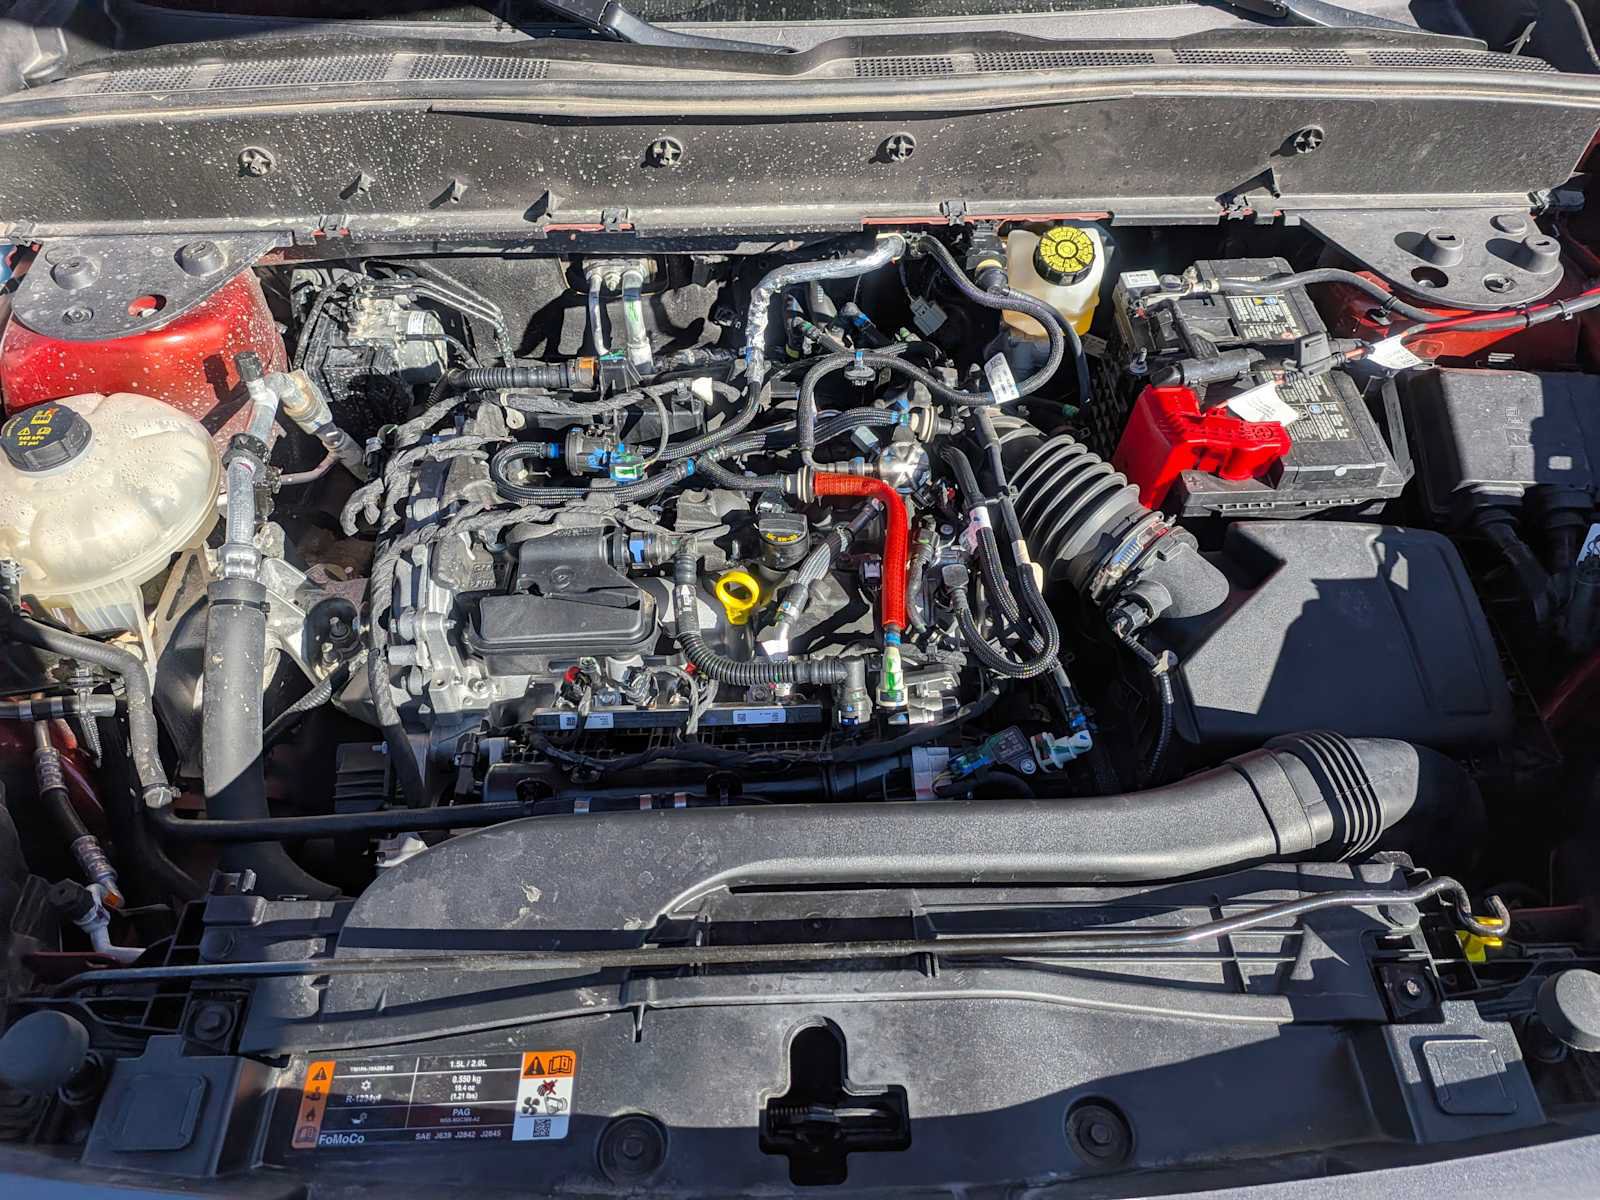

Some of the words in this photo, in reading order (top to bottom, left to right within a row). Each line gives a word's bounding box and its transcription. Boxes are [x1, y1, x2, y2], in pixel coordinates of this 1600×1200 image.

[450, 1060, 465, 1068] 1.5L
[470, 1059, 487, 1067] 2.0L
[472, 1074, 482, 1084] kg
[452, 1107, 471, 1116] PAG
[319, 1133, 365, 1144] FoMoCo
[415, 1132, 431, 1140] SAE
